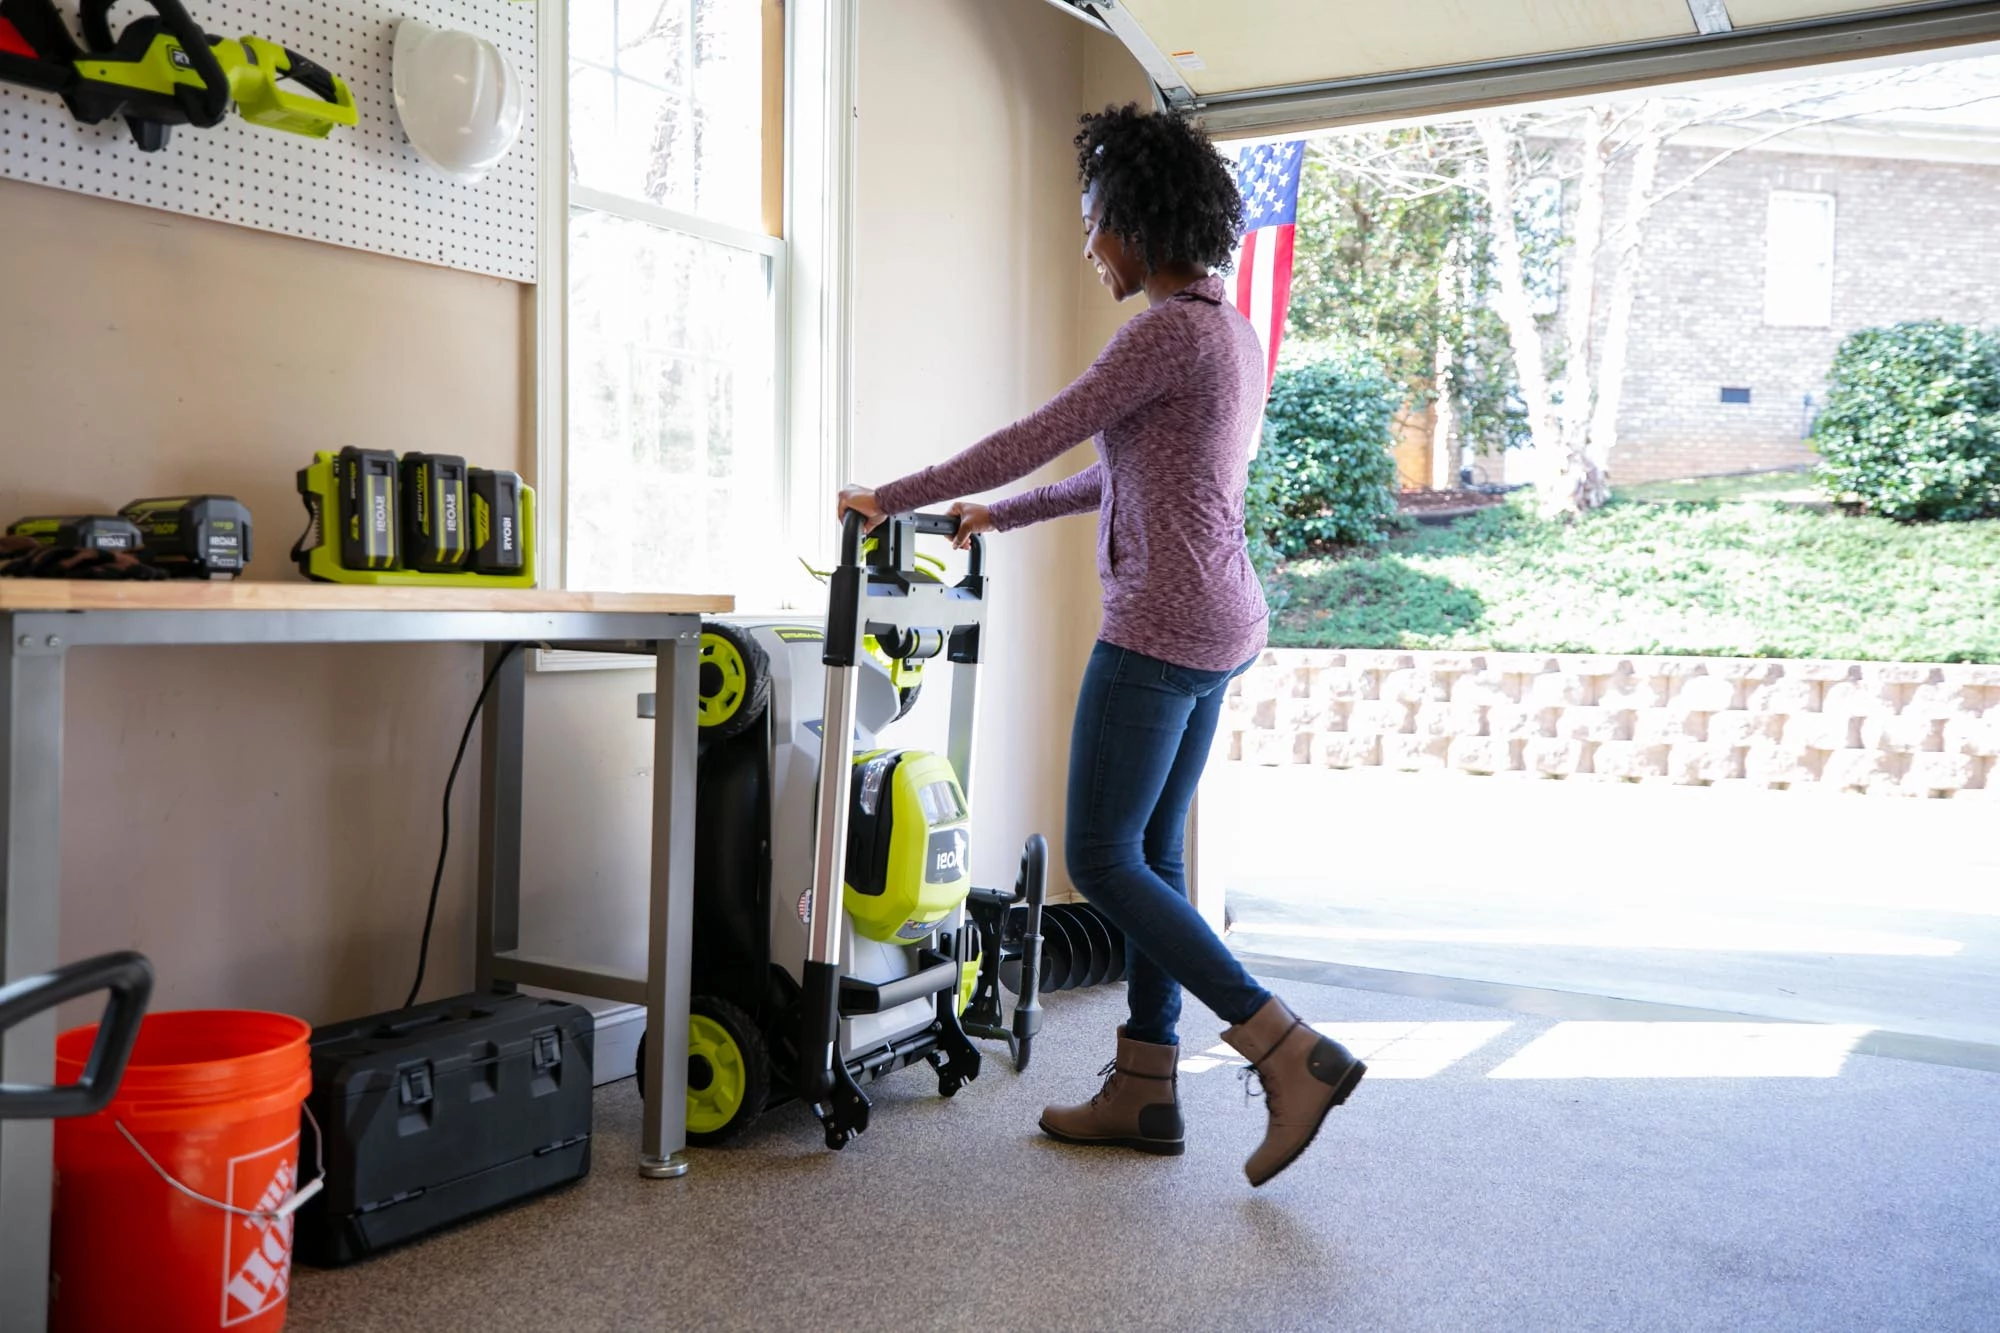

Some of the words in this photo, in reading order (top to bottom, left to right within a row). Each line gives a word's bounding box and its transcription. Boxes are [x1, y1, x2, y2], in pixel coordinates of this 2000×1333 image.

[376, 495, 387, 532] RYOBI
[446, 494, 457, 531] RYOBI
[208, 535, 238, 546] RYOBI
[502, 517, 513, 550] RYOBI
